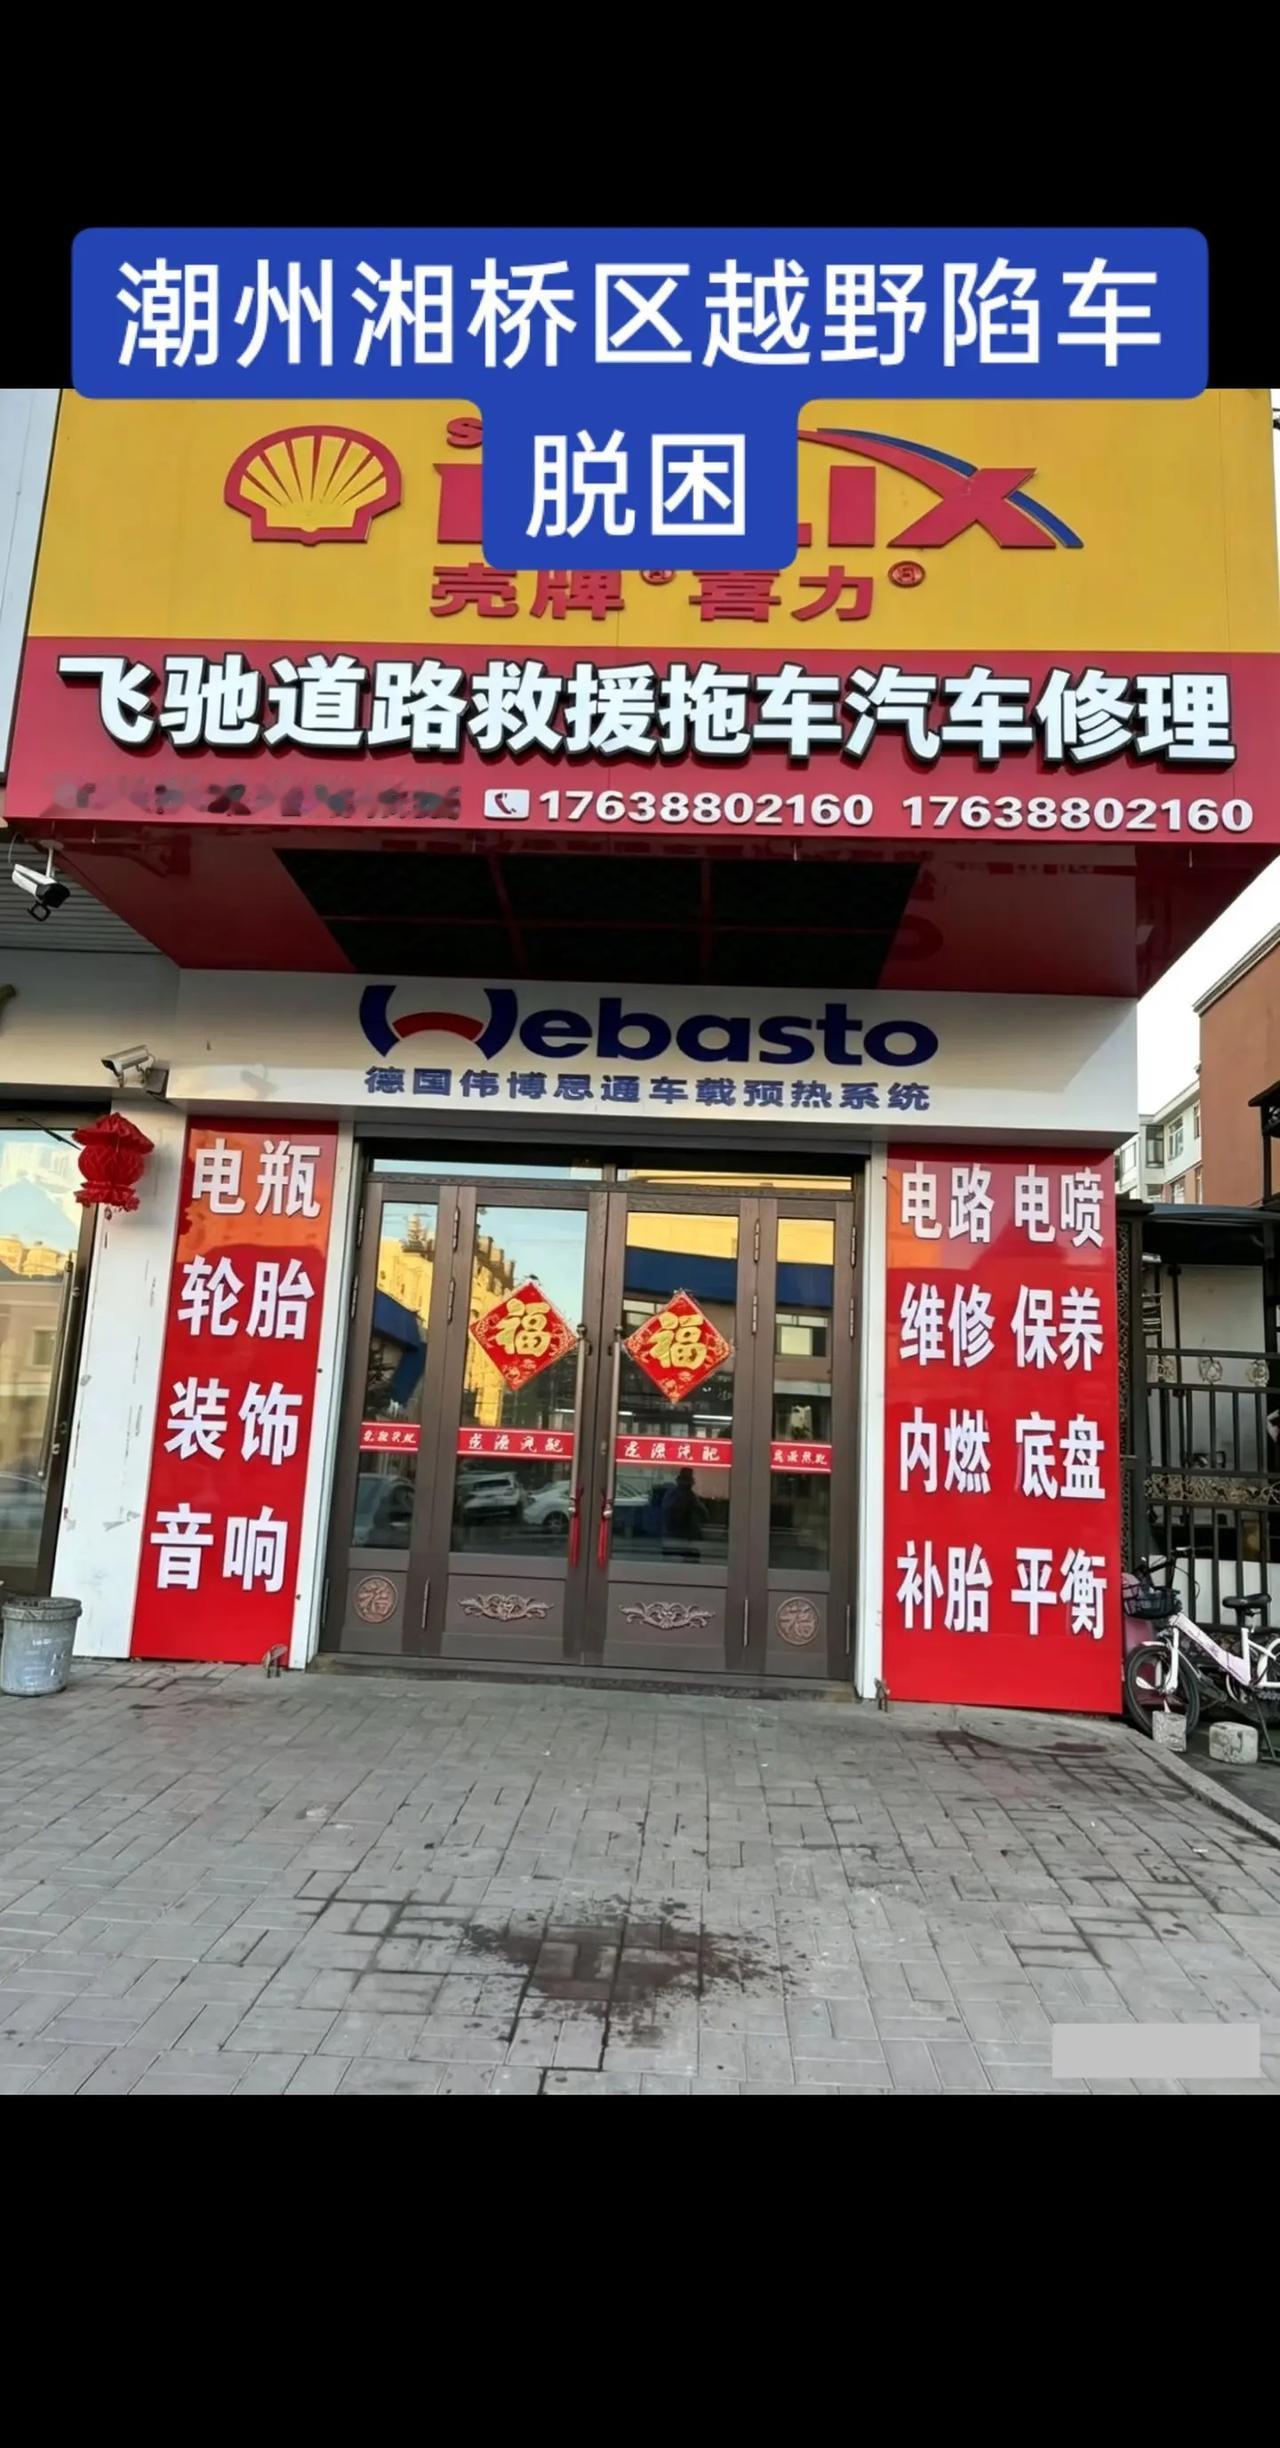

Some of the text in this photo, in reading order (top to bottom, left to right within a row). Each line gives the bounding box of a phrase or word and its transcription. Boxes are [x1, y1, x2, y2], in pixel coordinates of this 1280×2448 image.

[430, 563, 874, 623] 壳牌 喜力
[57, 654, 1238, 765] 飞驰道路救援拖车汽车修理
[539, 788, 1254, 833] 17638802160 17638802160
[359, 984, 938, 1068] Webasto
[190, 1137, 321, 1219] 电瓶
[901, 1162, 1104, 1249] 电路 电喷
[177, 1254, 316, 1340] 轮胎
[495, 1298, 551, 1358] 福
[899, 1281, 1104, 1372] 维修 保养
[650, 1311, 708, 1370] 福
[164, 1376, 303, 1467] 装饰
[899, 1406, 1106, 1499] 内燃 底盘
[150, 1501, 289, 1592] 音响
[896, 1539, 1108, 1640] 补胎 平衡
